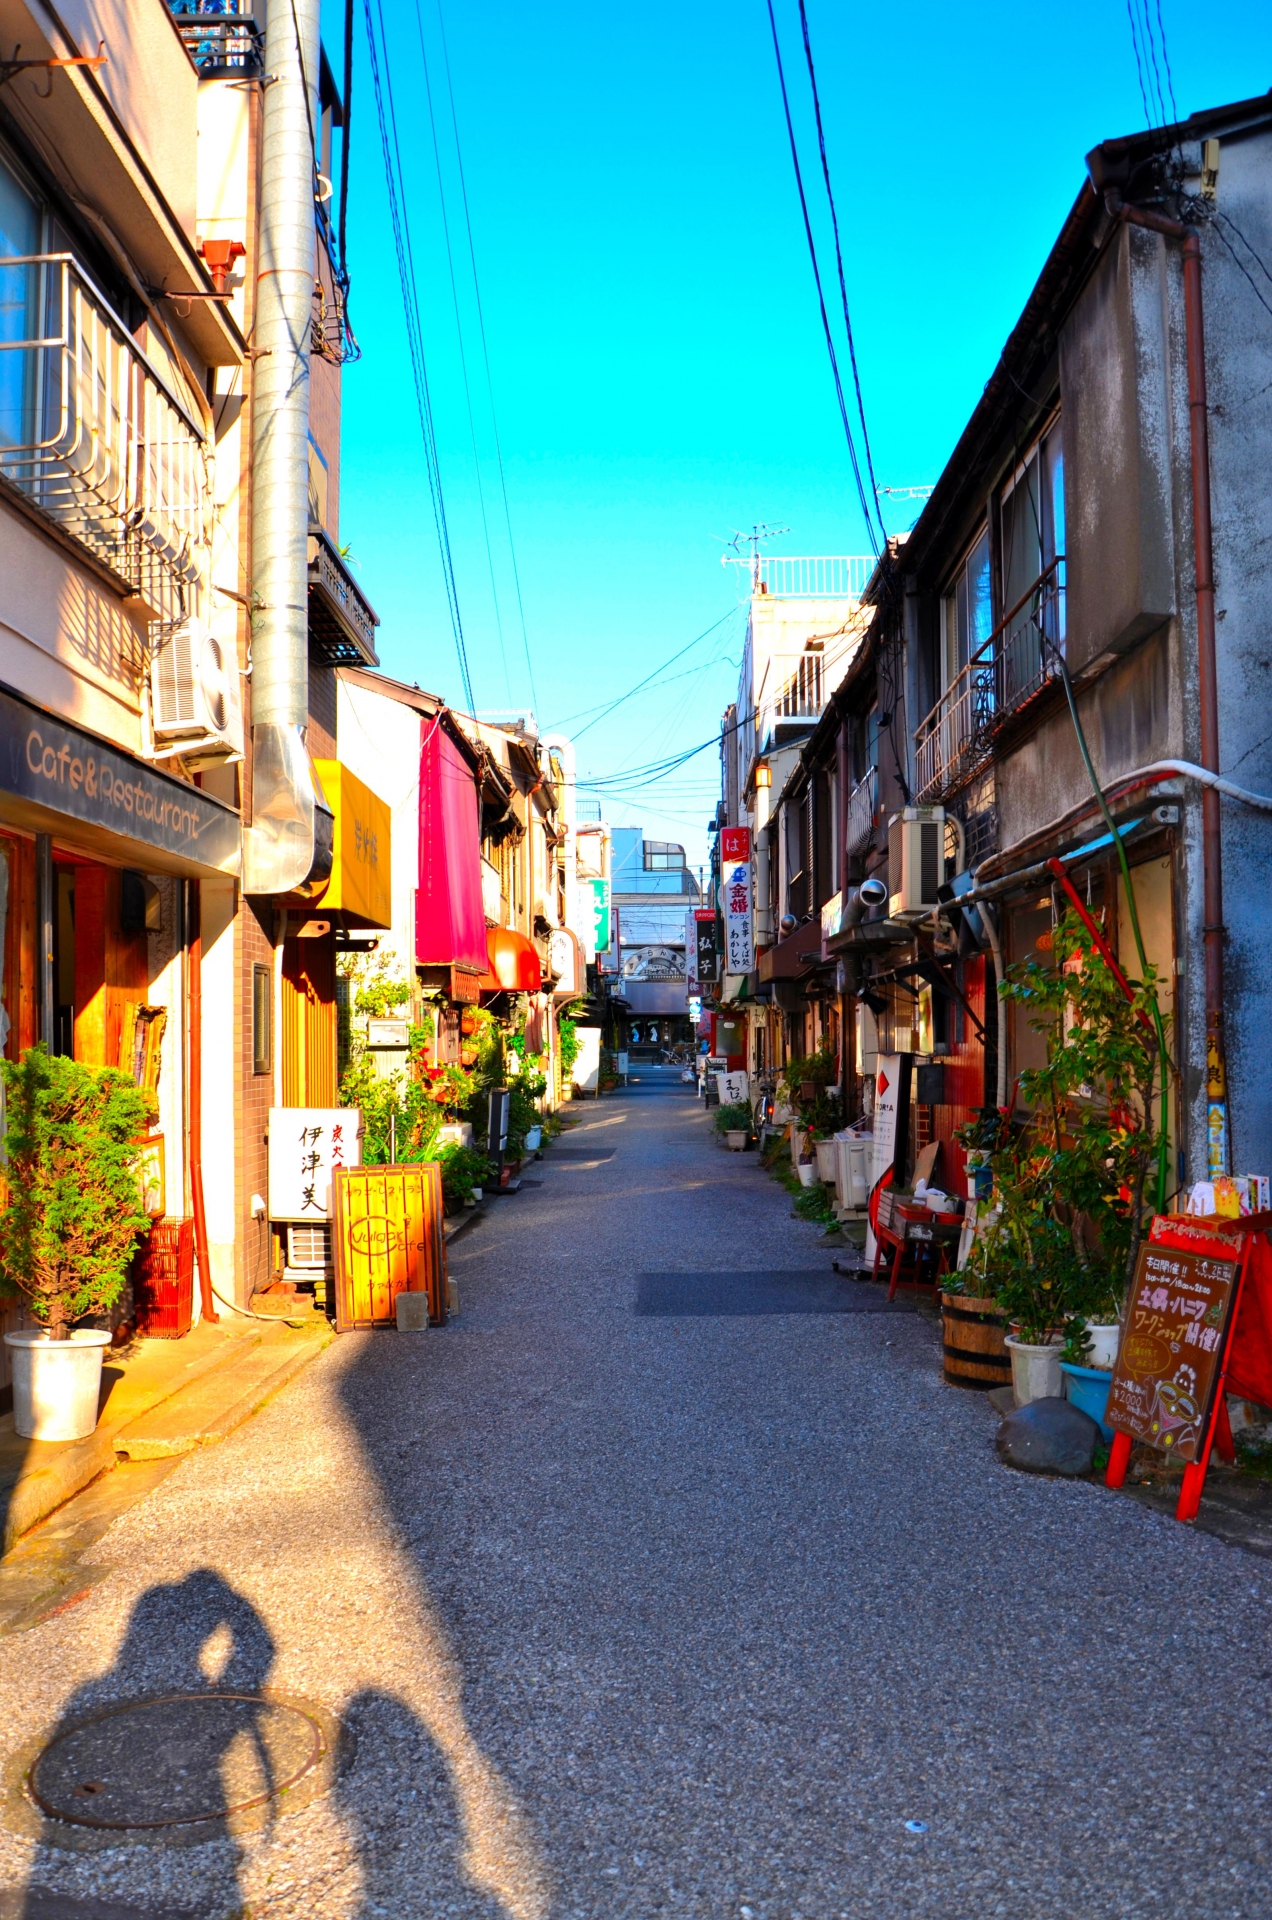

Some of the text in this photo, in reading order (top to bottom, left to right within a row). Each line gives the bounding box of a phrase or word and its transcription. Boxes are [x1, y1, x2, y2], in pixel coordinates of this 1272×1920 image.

[728, 883, 749, 913] 金婚
[699, 937, 712, 974] 弘子
[730, 929, 741, 968] あかしや
[741, 921, 752, 966] 食事 そば処
[331, 1124, 344, 1167] 炭火
[298, 1126, 328, 1213] 伊津美
